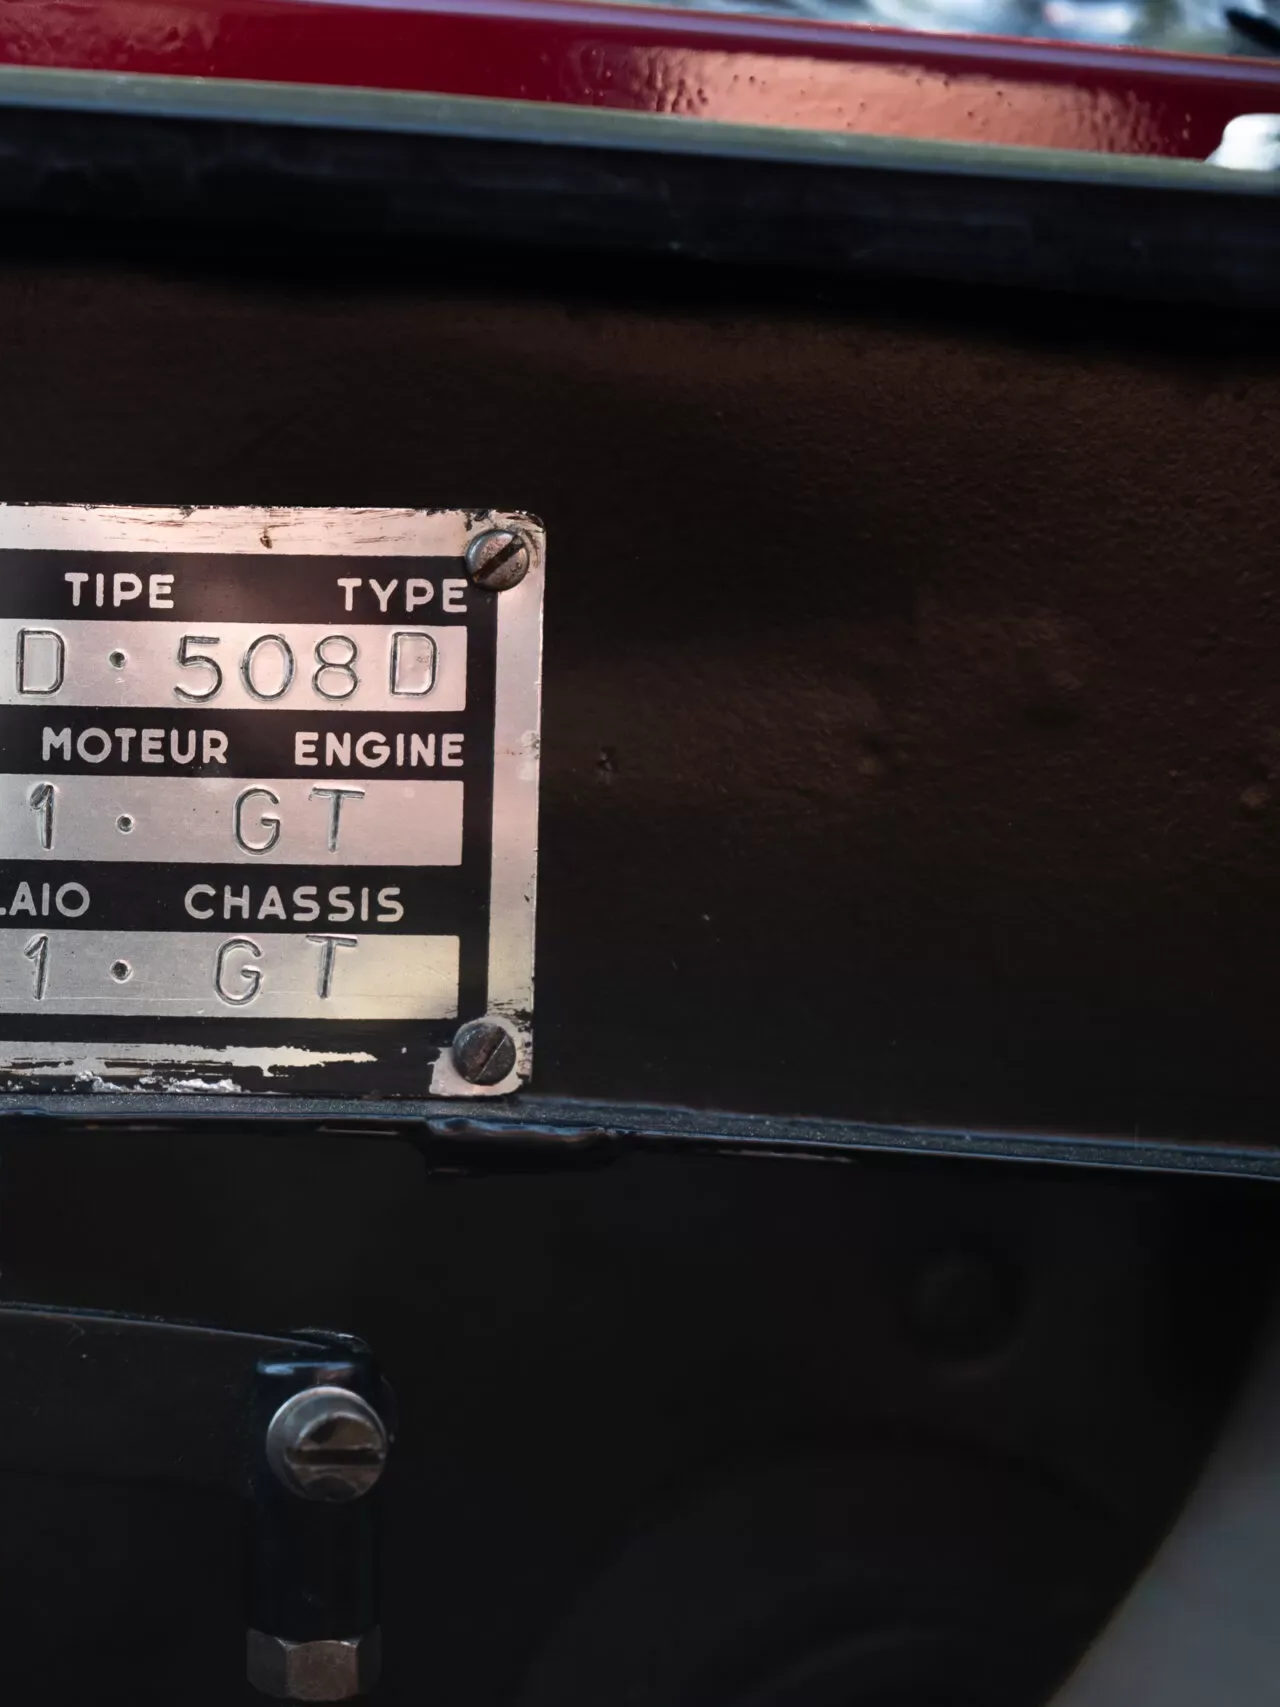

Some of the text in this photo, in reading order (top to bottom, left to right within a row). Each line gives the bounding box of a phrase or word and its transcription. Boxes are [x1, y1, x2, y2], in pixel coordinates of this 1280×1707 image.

[64, 572, 175, 609] TIPE
[337, 578, 468, 613] TYPE
[174, 630, 438, 702] 508D
[41, 726, 229, 764] MOTEUR
[294, 731, 465, 768] ENGINE
[233, 784, 366, 855] GT
[183, 883, 405, 923] CHASSIS
[213, 933, 359, 1006] GT
